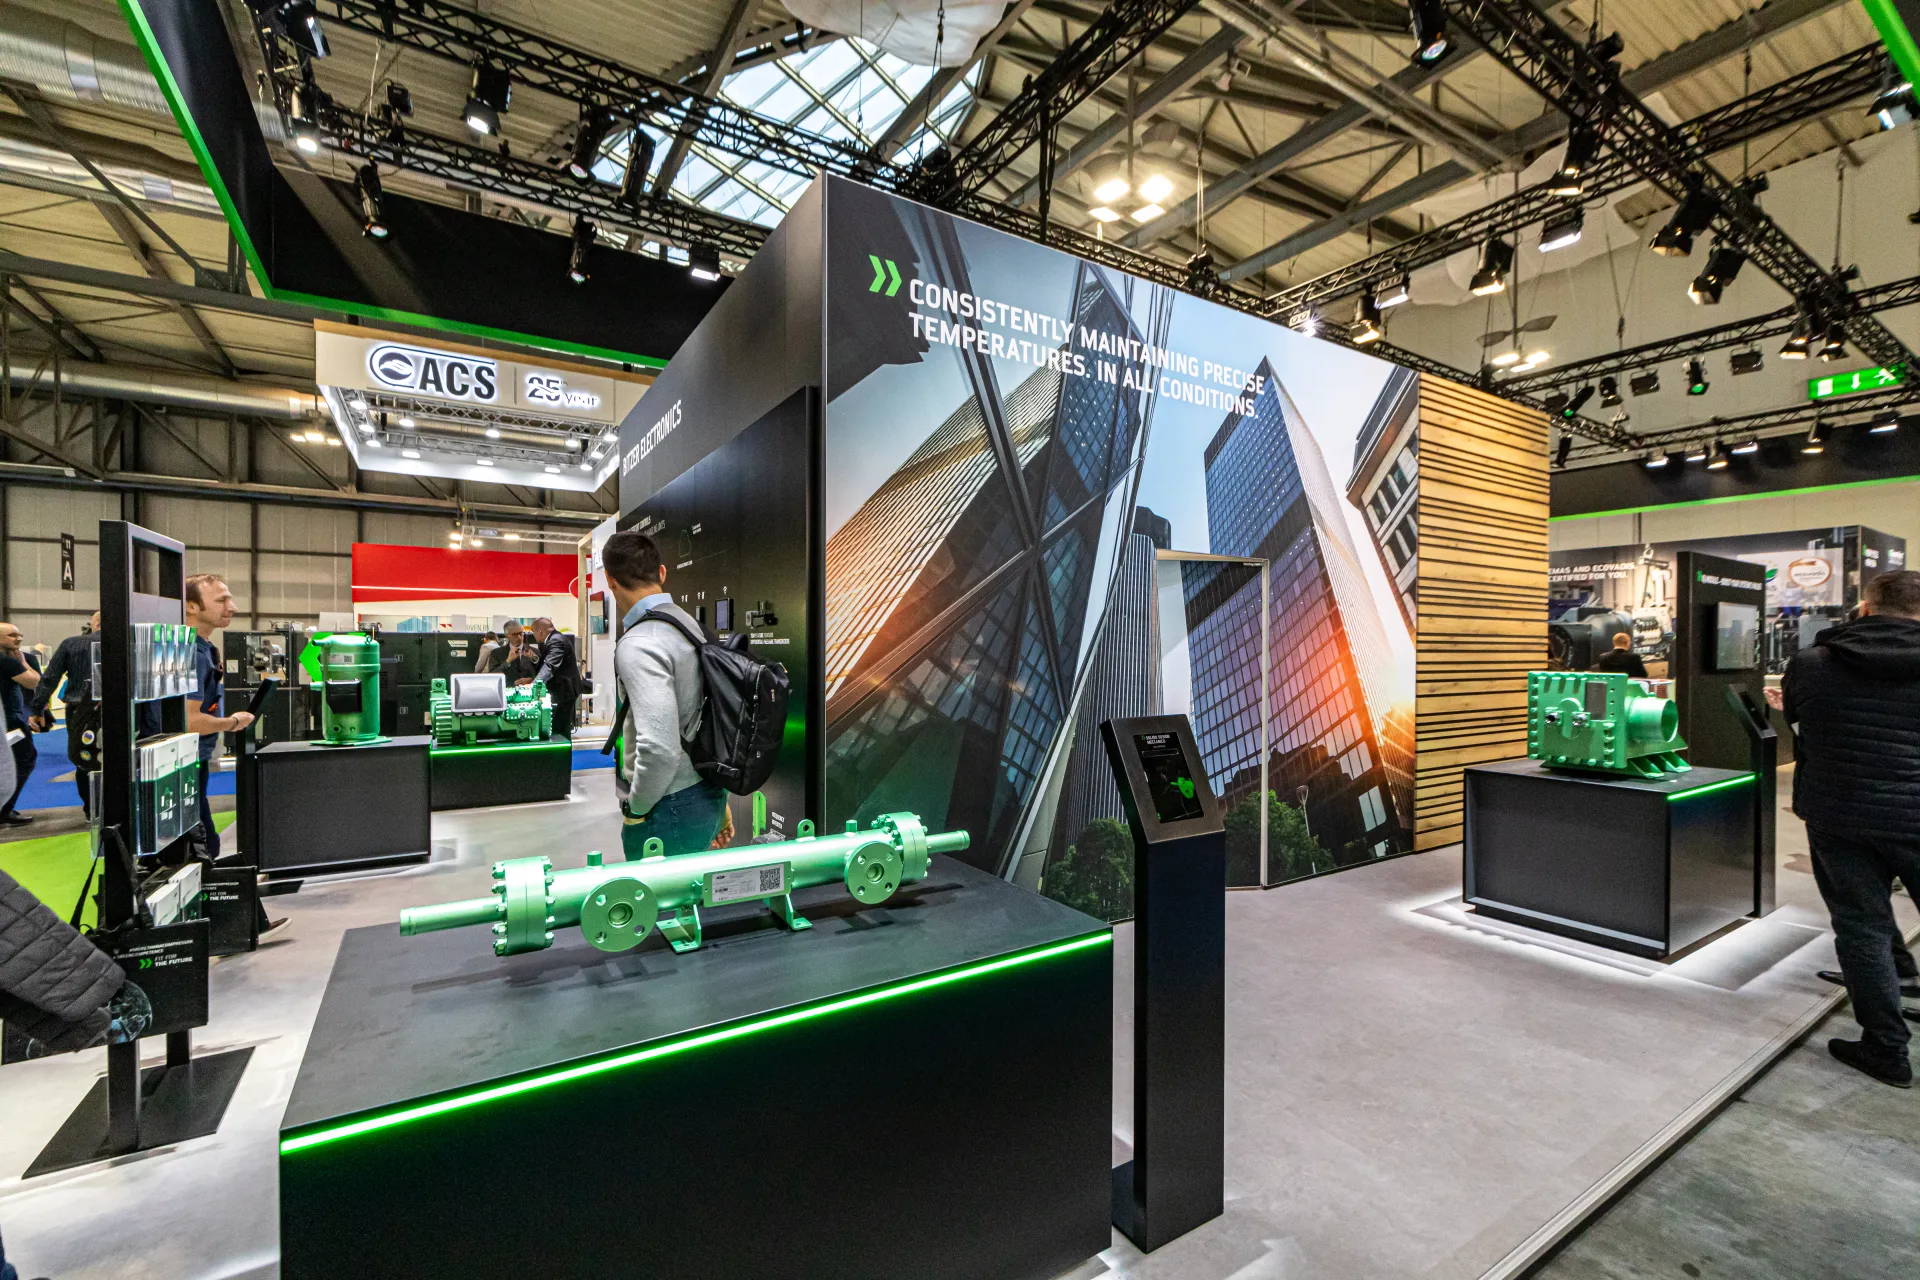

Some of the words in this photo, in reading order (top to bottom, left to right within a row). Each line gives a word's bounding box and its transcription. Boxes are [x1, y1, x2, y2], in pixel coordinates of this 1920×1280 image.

[909, 279, 1074, 343] CONSISTENTLY
[1080, 325, 1199, 377] MAINTAINING
[1204, 360, 1265, 396] PRECISE
[908, 311, 1090, 379] TEMPERATURES.
[1097, 359, 1117, 385] IN
[1122, 368, 1154, 394] ALL
[1159, 375, 1260, 419] CONDITIONS.
[419, 357, 496, 400] ACS
[564, 392, 598, 406] year
[623, 443, 640, 477] BITZER
[640, 400, 682, 460] ELECTRONICS
[63, 560, 73, 582] A
[1548, 573, 1588, 583] CERTIFIED
[1589, 572, 1606, 580] FOR
[1573, 565, 1591, 573] AND
[168, 957, 193, 965] FUTURE
